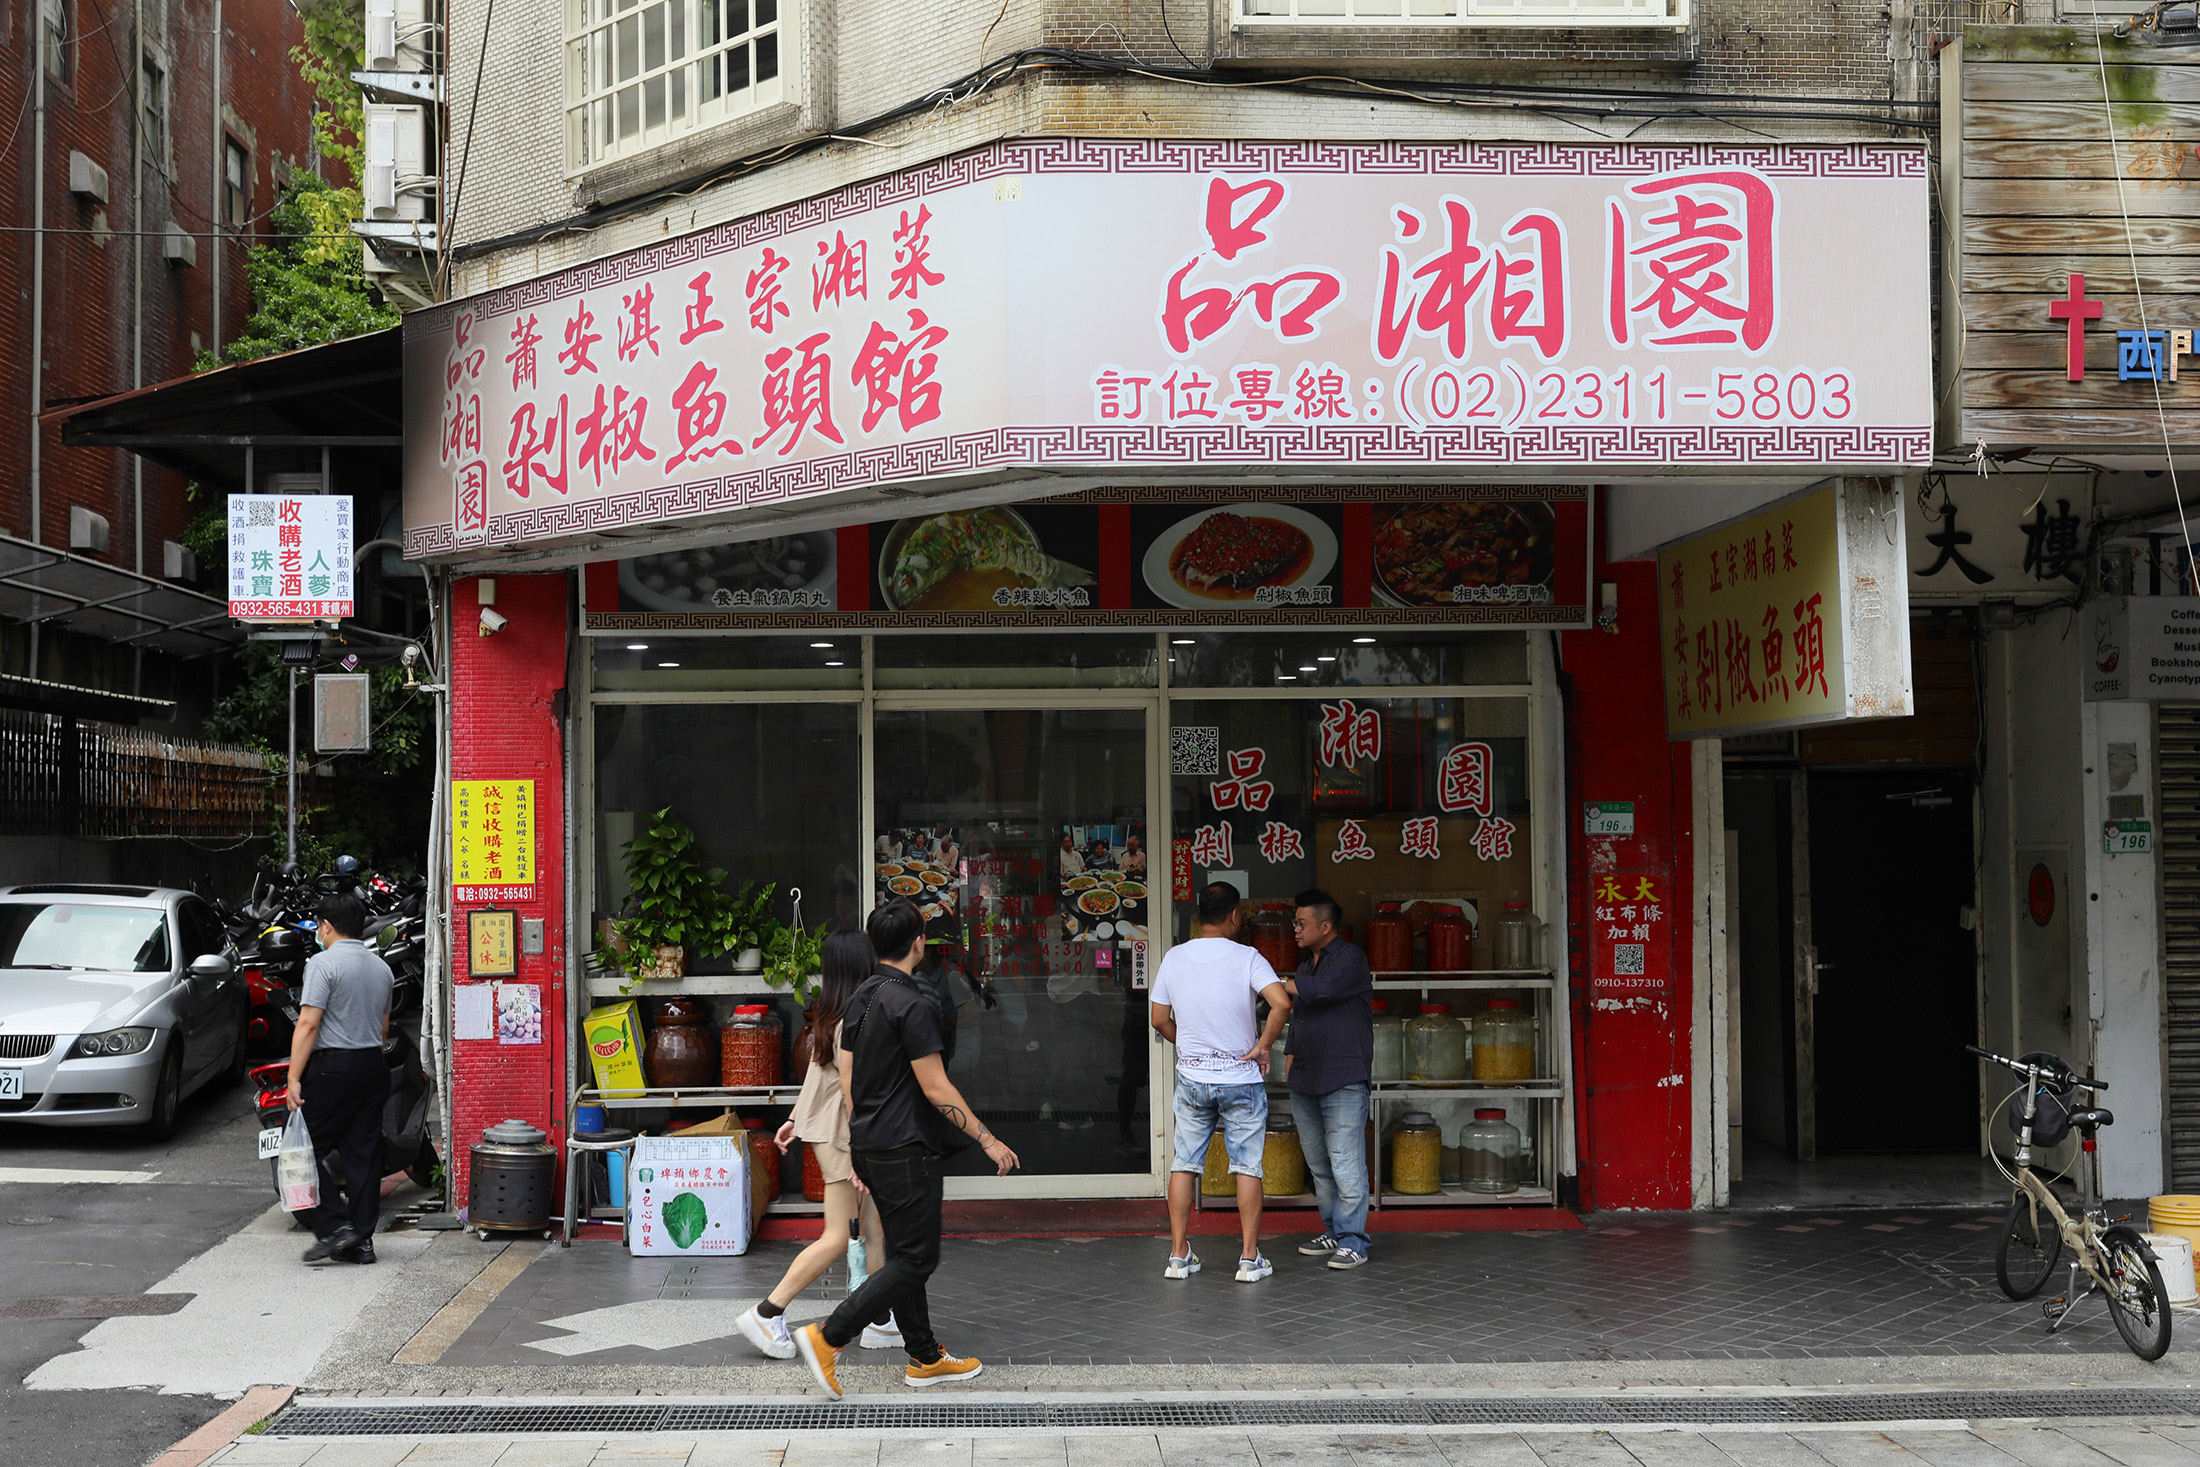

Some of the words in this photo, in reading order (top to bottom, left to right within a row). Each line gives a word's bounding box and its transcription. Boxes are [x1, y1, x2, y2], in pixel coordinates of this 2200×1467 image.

[1160, 172, 1775, 360] 品湘園
[505, 203, 945, 392] 蕭安淇正宗湘菜
[503, 309, 949, 498] 剁椒魚頭館
[441, 309, 488, 531] 品湘園
[279, 499, 303, 597] 收購老酒
[336, 499, 350, 597] 愛買家行動商店
[1914, 499, 2087, 585] 大樓
[1710, 520, 1797, 594] 正宗湖南菜
[251, 549, 274, 598] 珠寶
[994, 588, 1090, 608] 香辣跳水魚
[1255, 586, 1332, 604] 剁椒魚頭
[1454, 585, 1549, 603] 湘味啤酒鴨
[232, 602, 318, 616] 0932-565-431
[320, 602, 350, 616] 黃鎮州
[2171, 610, 2200, 620] Coffe
[1671, 559, 1691, 720] 蕭安淇
[1695, 592, 1829, 715] 剁椒魚頭
[2151, 657, 2200, 668] Booksho
[1210, 700, 1493, 816] 品湘園
[482, 785, 504, 880] 誠信收購老酒
[1600, 820, 1620, 832] 196
[1192, 816, 1516, 869] 剁椒魚頭館
[2121, 835, 2147, 848] 196
[969, 858, 1045, 877] 歡迎光臨
[1596, 876, 1661, 903] 永大
[965, 894, 1055, 918] 品湘園
[1595, 904, 1664, 923] 紅布條
[972, 923, 1048, 941] 營業時間
[1607, 924, 1651, 941] 加賴
[480, 930, 495, 966] 公休
[1594, 977, 1665, 988] 0910-137310
[0, 1077, 19, 1094] 21
[661, 1167, 728, 1180] 埤頭鄉農會
[641, 1196, 653, 1248] 包心白菜
